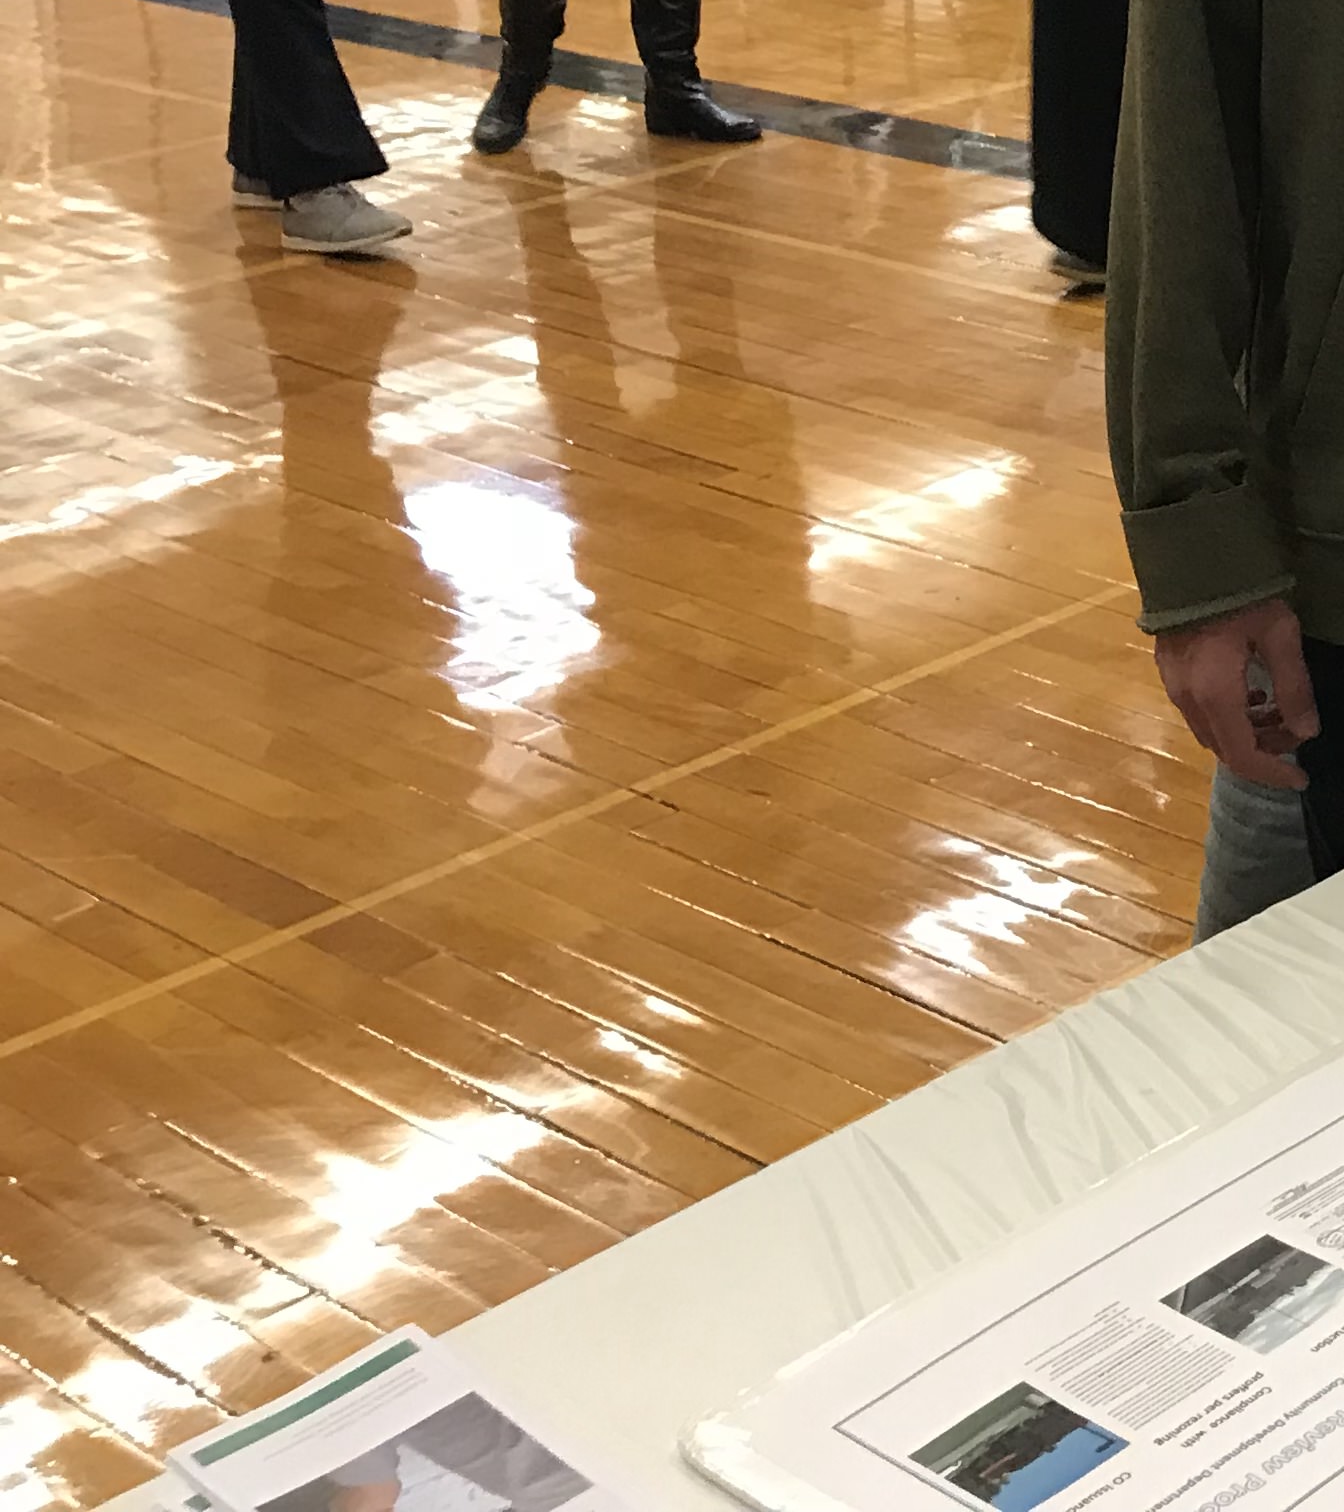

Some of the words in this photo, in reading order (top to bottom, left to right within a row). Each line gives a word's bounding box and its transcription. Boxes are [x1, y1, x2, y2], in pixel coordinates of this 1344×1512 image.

[1205, 1384, 1274, 1430] Compliance
[1177, 1428, 1210, 1449] with
[1207, 1417, 1288, 1471] Development
